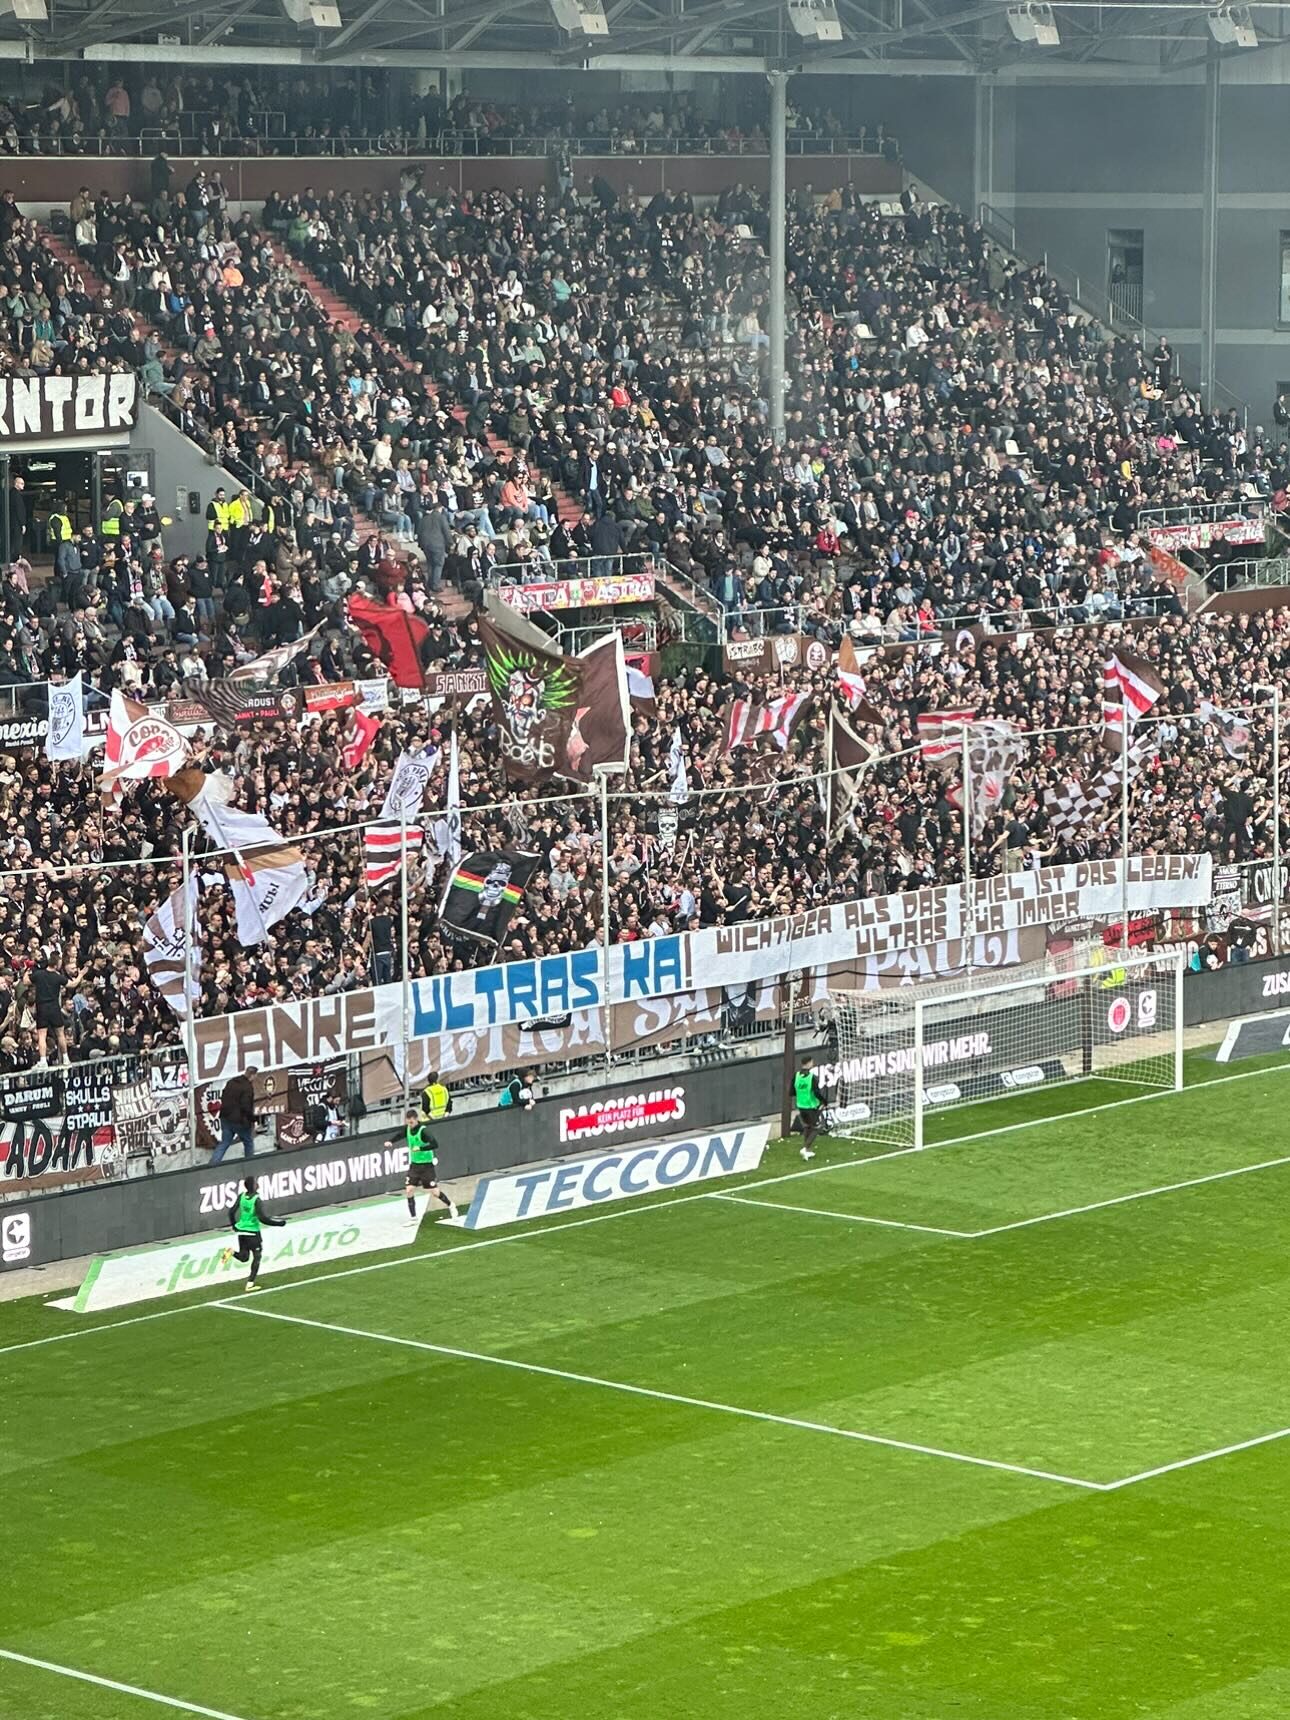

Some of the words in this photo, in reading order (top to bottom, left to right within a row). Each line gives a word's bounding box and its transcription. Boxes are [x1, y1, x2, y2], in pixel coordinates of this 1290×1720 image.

[595, 579, 652, 600] ASTRA
[716, 907, 832, 954] WICHTIGER
[845, 896, 891, 930] ALS
[903, 887, 947, 919] DAS
[1034, 866, 1066, 895] IST
[1076, 861, 1118, 888] DAS
[1127, 855, 1202, 882] LEBEN!
[856, 914, 947, 955] ULTRAS
[1017, 890, 1080, 926] IMMER
[194, 990, 388, 1081] DANKE,
[412, 950, 599, 1037] ULTRAS
[921, 1040, 948, 1068] WIR
[949, 1032, 992, 1062] MEHR.
[4, 1086, 53, 1106] DARUM
[63, 1074, 113, 1089] YOUTH
[66, 1087, 111, 1106] SKULLS
[200, 1168, 302, 1213] ZUSMEN
[304, 1159, 347, 1192] SIND
[348, 1152, 382, 1182] WIR
[515, 1132, 745, 1217] TECCON
[273, 1228, 360, 1261] AUTO
